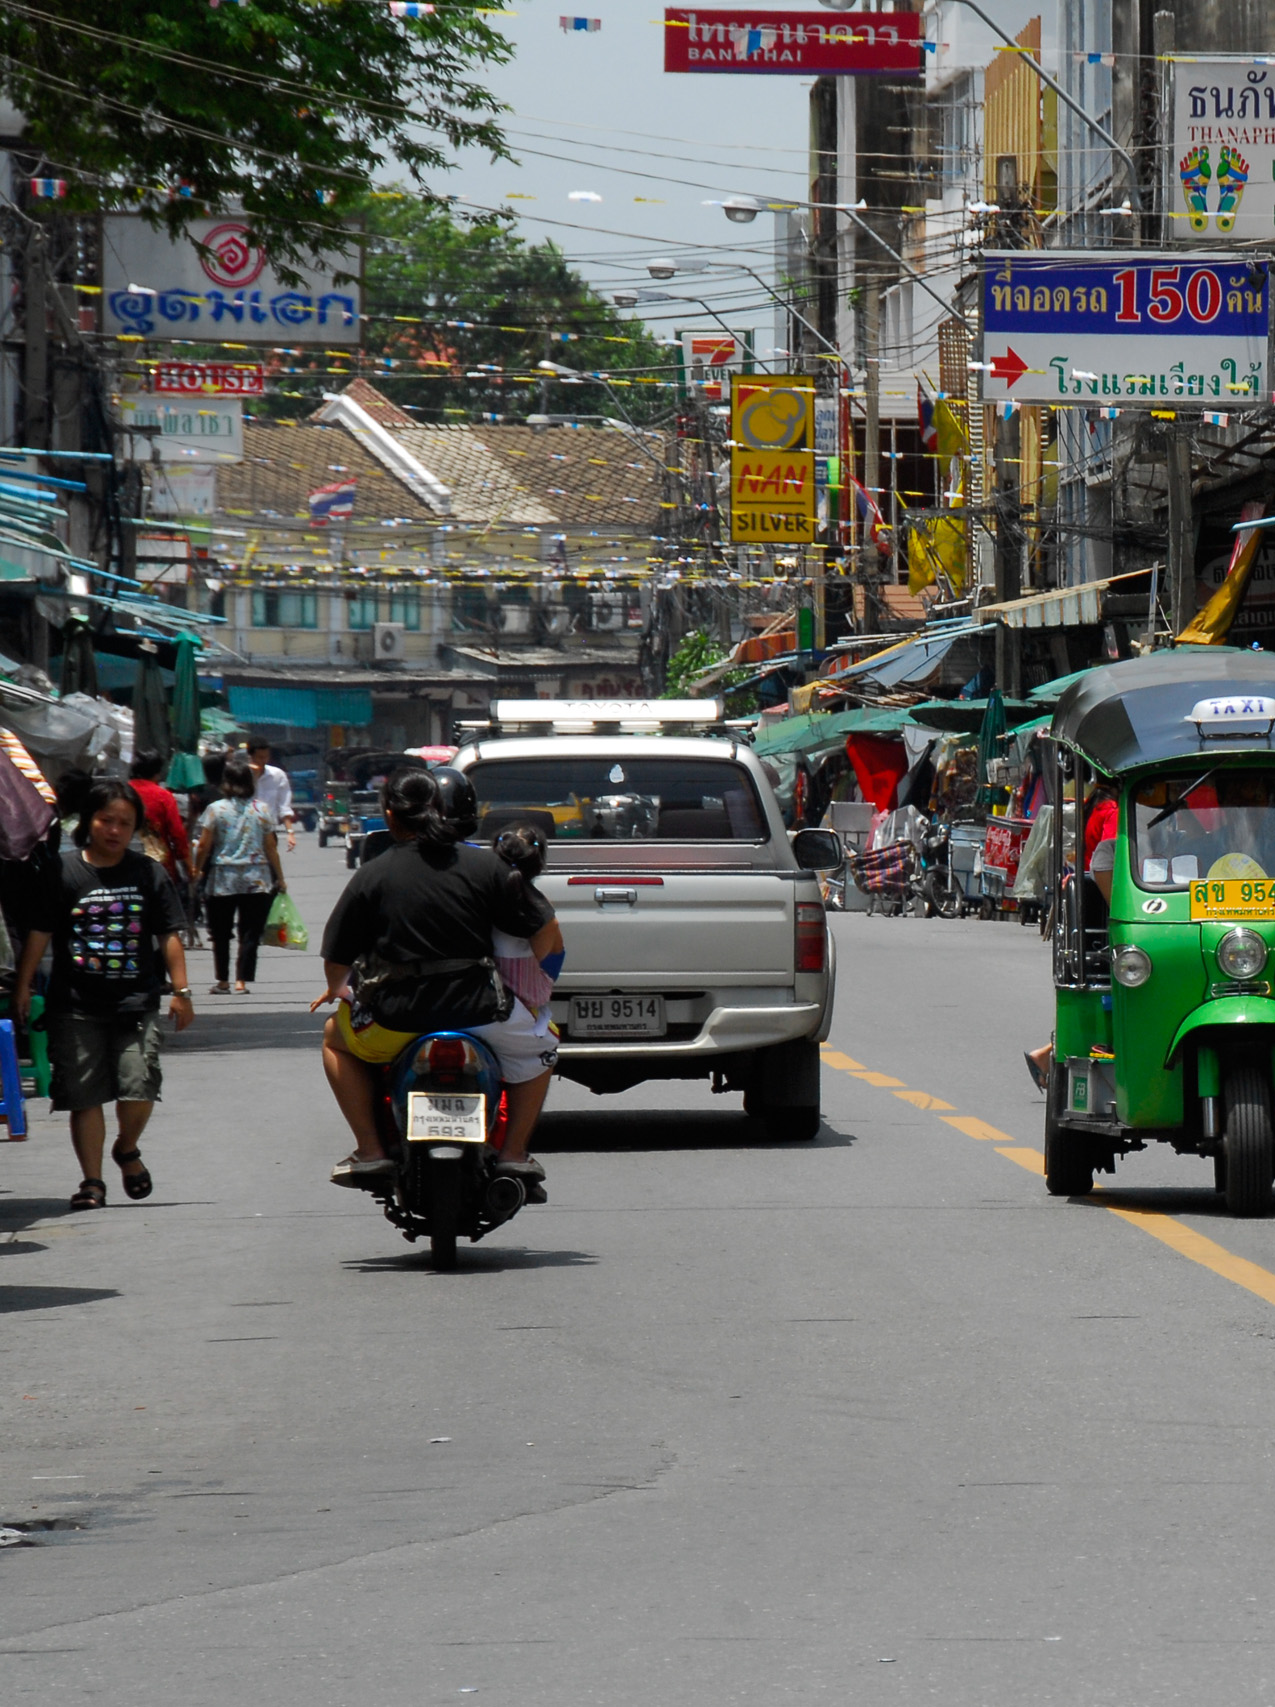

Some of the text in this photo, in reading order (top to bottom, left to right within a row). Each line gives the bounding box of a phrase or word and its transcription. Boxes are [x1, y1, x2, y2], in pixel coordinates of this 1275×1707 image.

[991, 259, 1263, 324] ที่จอดรถ 150 คัน
[692, 339, 736, 367] 7
[158, 366, 260, 391] HOUSE
[1049, 356, 1263, 396] โรงแรมเวียงใต้
[737, 464, 807, 495] NAN
[737, 512, 810, 533] SILVER
[562, 702, 653, 714] TOYOTA
[1209, 699, 1265, 715] TAXI
[1194, 881, 1225, 903] สข
[611, 1000, 656, 1018] 9514
